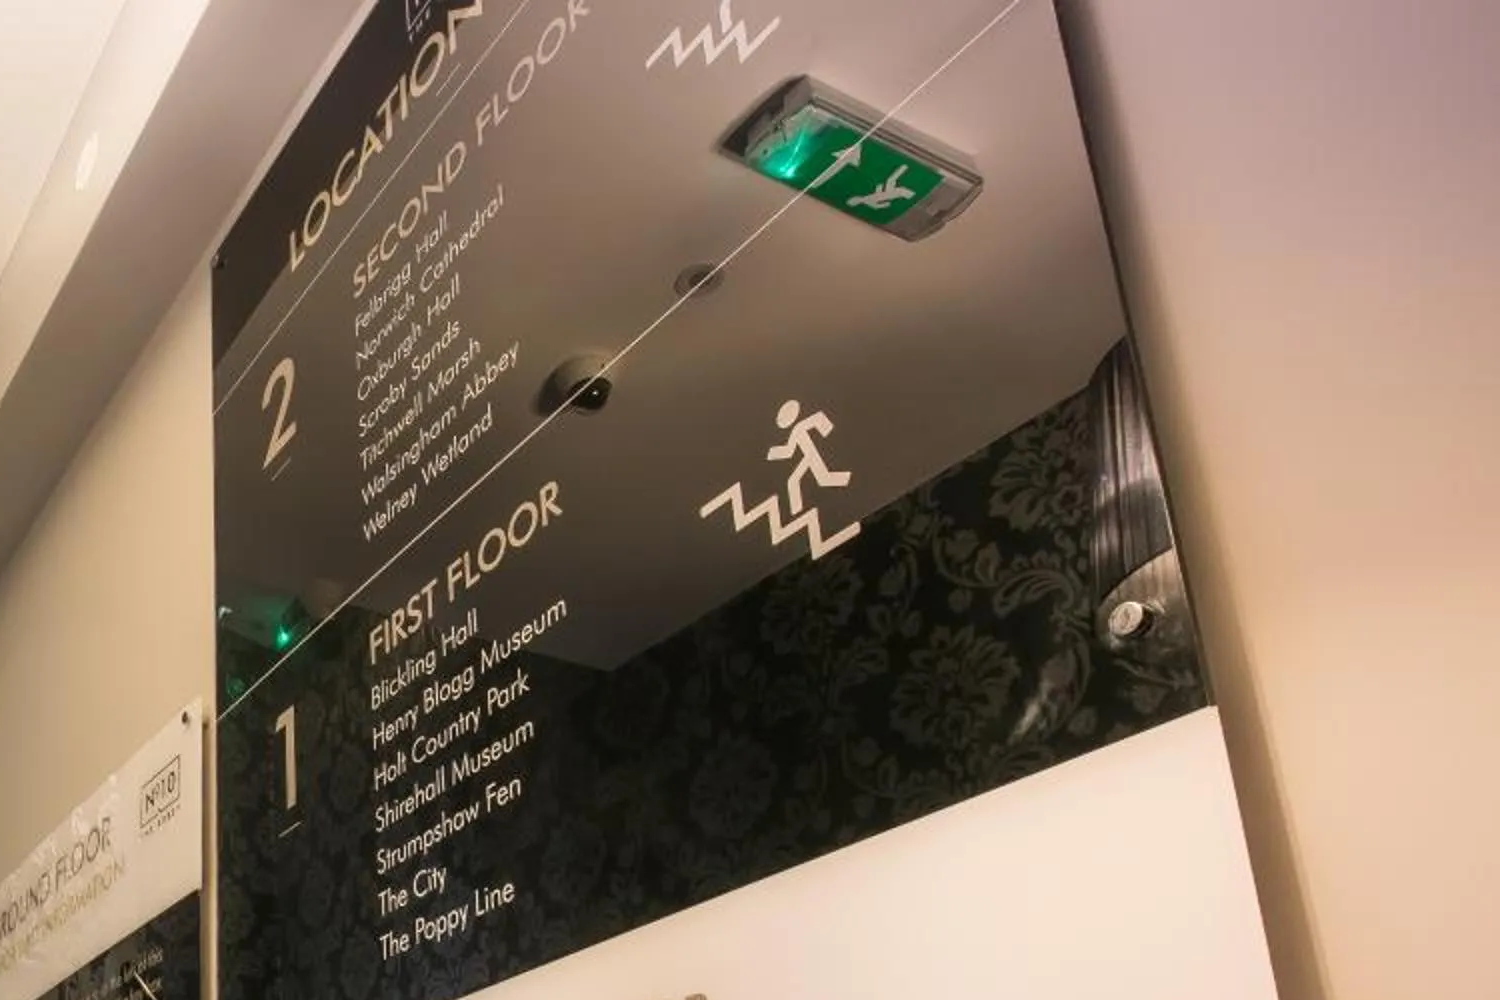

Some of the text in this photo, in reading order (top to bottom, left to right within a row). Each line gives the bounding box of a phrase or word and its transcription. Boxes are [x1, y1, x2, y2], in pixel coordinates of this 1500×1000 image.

[353, 0, 590, 299] SECOND FLOOR
[355, 209, 448, 337] Felbrigg Hall
[356, 183, 504, 370] Norwich Cathedral
[357, 271, 460, 401] Oxburgh Hall
[358, 319, 461, 438] Scroby Sands
[261, 357, 298, 470] 2
[359, 336, 482, 471] Titchwell Marsh
[360, 340, 519, 506] Walsingham Abbey
[363, 401, 494, 543] Welney Wetland
[368, 480, 564, 666] FIRST FLOOR
[370, 607, 479, 711] Blickling Hall
[372, 598, 568, 751] Henry Blogg Museum
[275, 703, 299, 812] 1
[373, 667, 531, 792] Holt Country Park
[374, 720, 536, 833] Shirehall Museum
[55, 816, 111, 892] FLOOR
[376, 777, 522, 876] Strumpshaw Fen
[377, 864, 448, 917] The City
[379, 881, 517, 961] The Poppy Line
